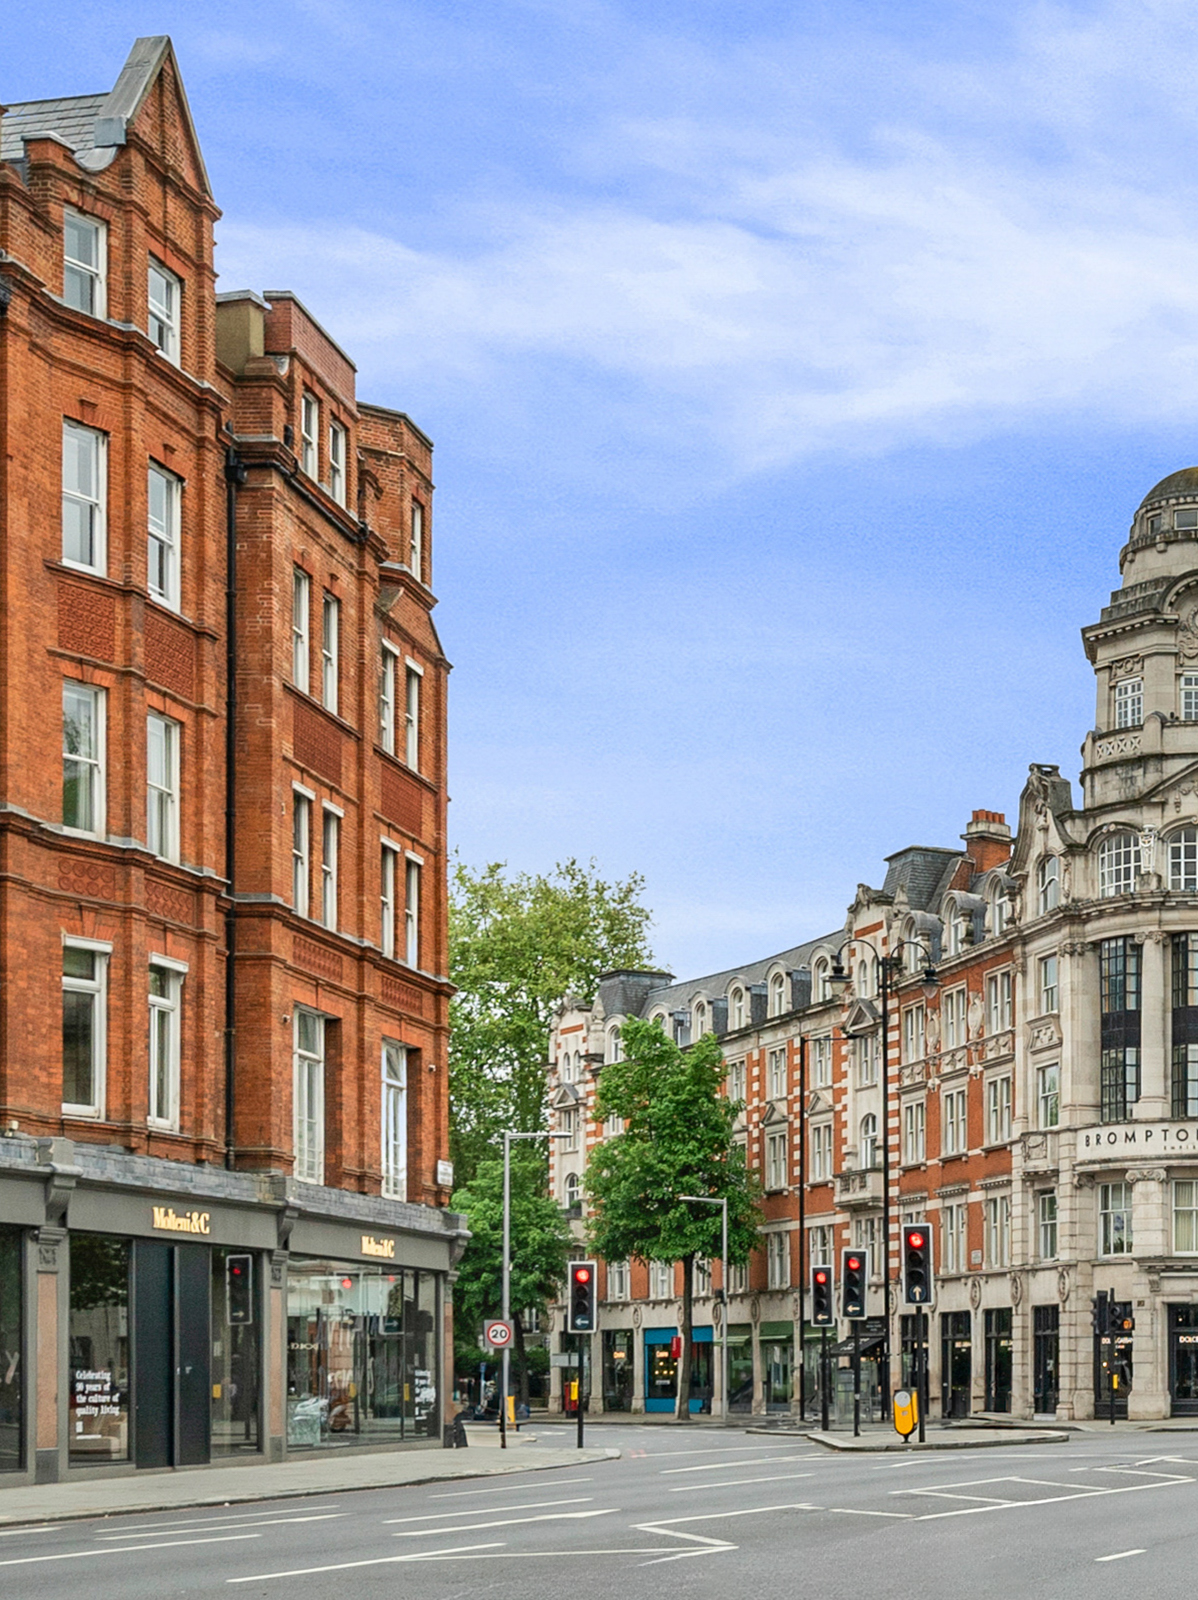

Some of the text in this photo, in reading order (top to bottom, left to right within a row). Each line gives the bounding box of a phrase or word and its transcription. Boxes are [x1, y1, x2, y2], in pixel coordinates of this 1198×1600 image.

[152, 1206, 210, 1234] Molteni&C
[491, 1329, 508, 1339] 20
[76, 1370, 111, 1382] Celebrating
[85, 1384, 101, 1394] years
[103, 1382, 111, 1391] of
[76, 1393, 120, 1403] the culture of
[76, 1405, 120, 1417] quality living
